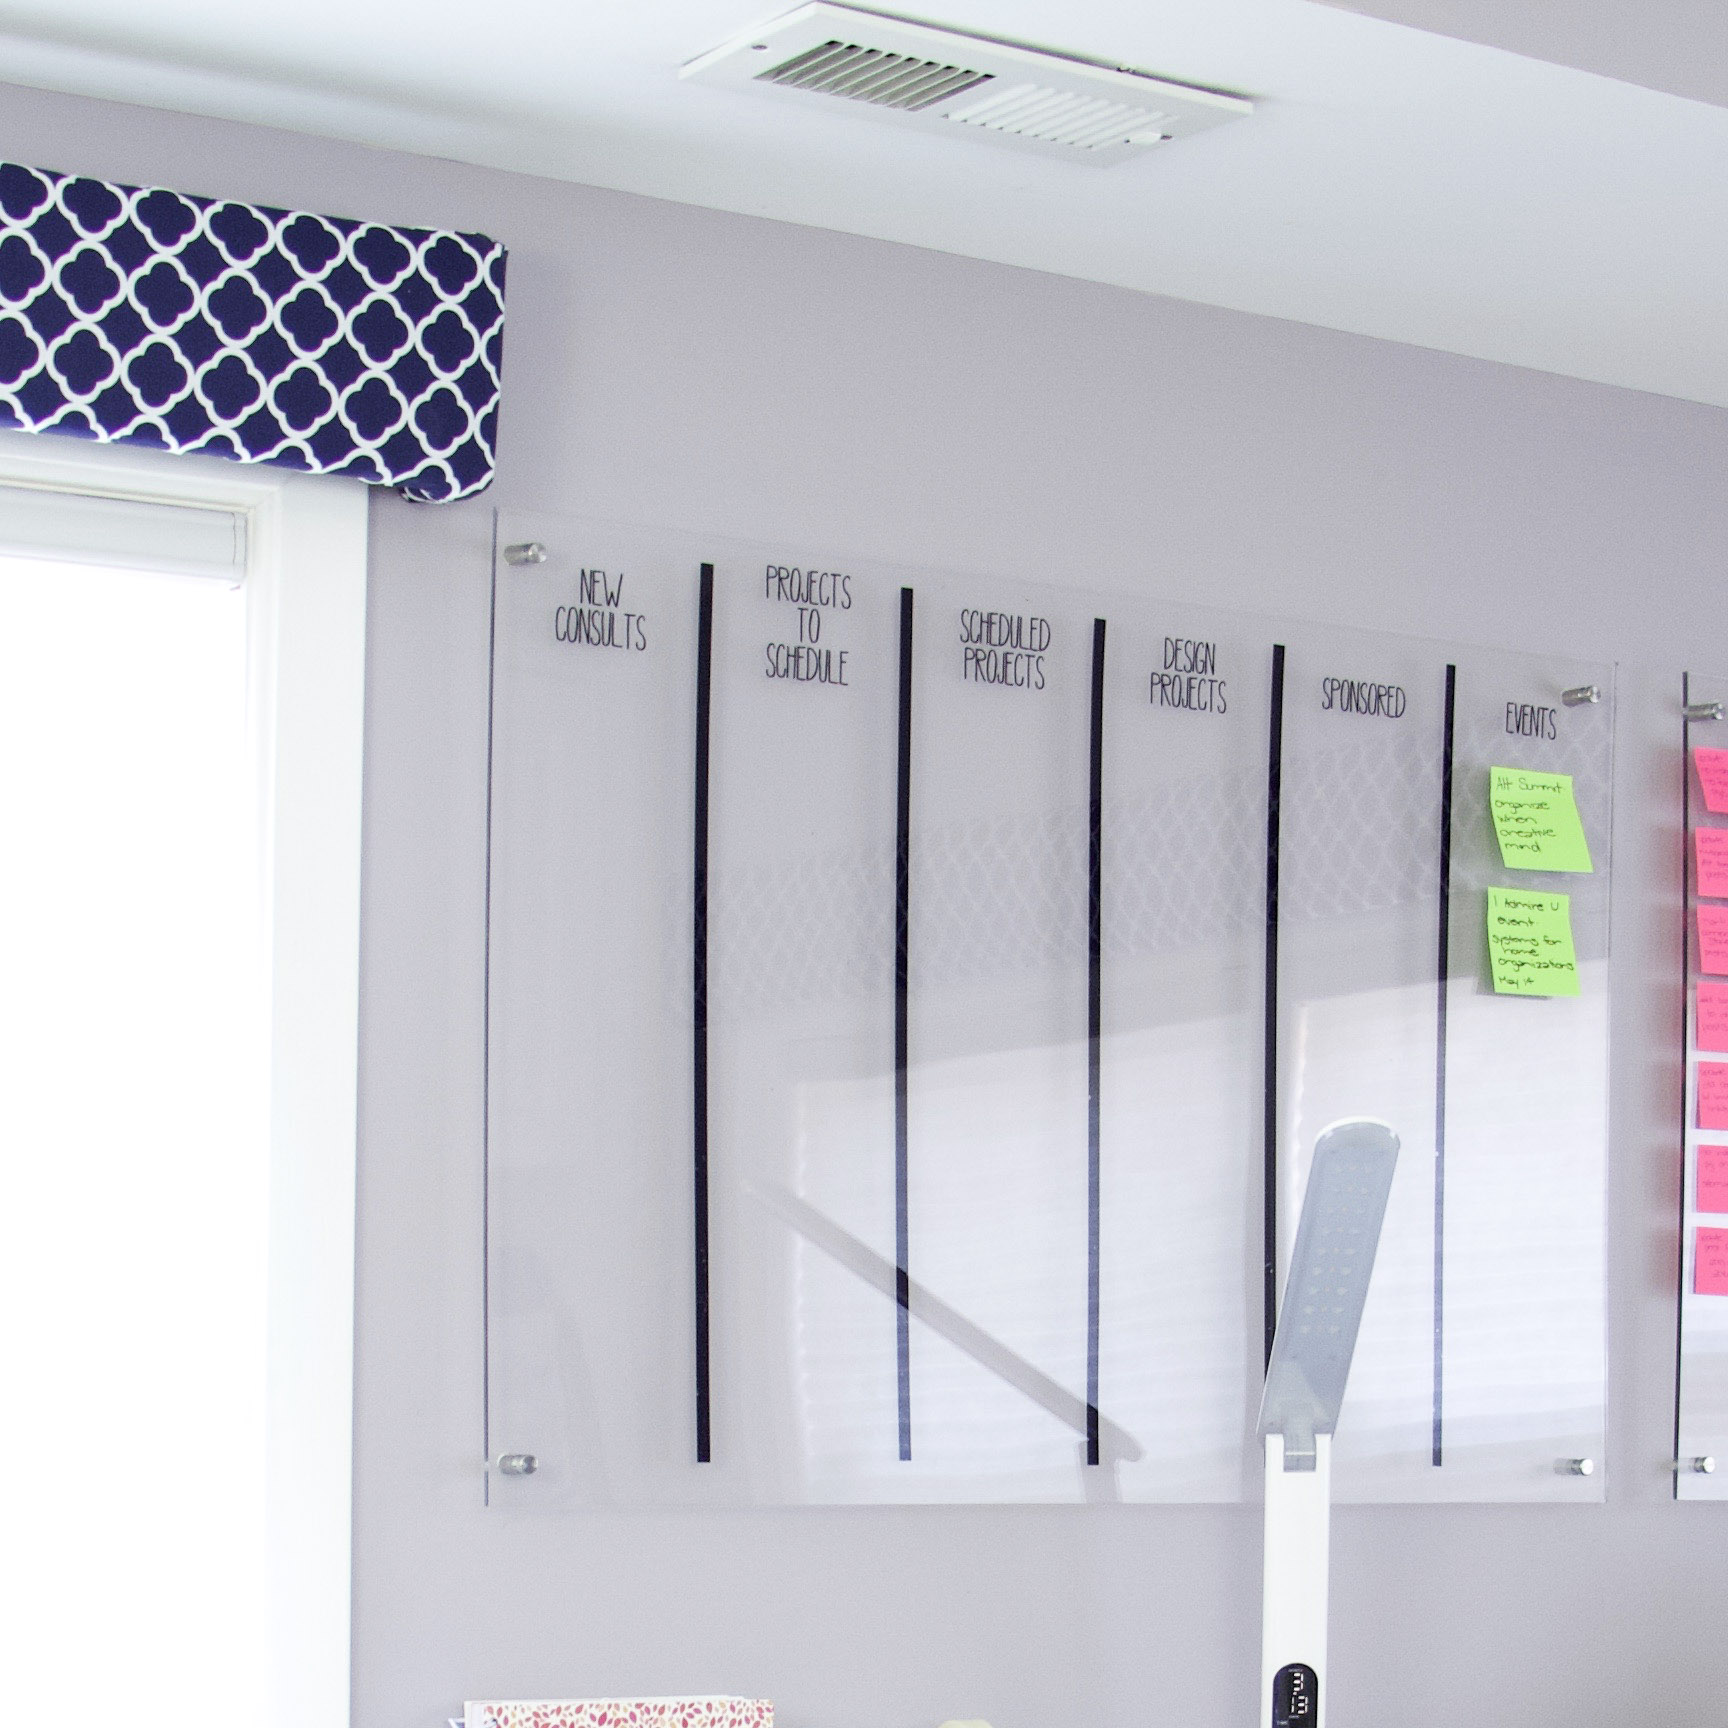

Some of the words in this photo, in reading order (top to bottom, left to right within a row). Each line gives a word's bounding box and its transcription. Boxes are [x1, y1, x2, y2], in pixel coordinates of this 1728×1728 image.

[580, 568, 624, 608] NEW
[765, 565, 852, 610] PROJECTS
[555, 606, 647, 651] CONSULTS
[797, 607, 821, 644] TO
[960, 608, 1051, 652] SCHEDULED
[765, 642, 850, 686] SCHEDULE
[963, 646, 1045, 690] PROJECTS
[1163, 636, 1216, 676] DESIGN
[1150, 671, 1227, 714] PROJECTS
[1321, 677, 1406, 719] SPONSORED
[1505, 701, 1557, 740] EVENTS
